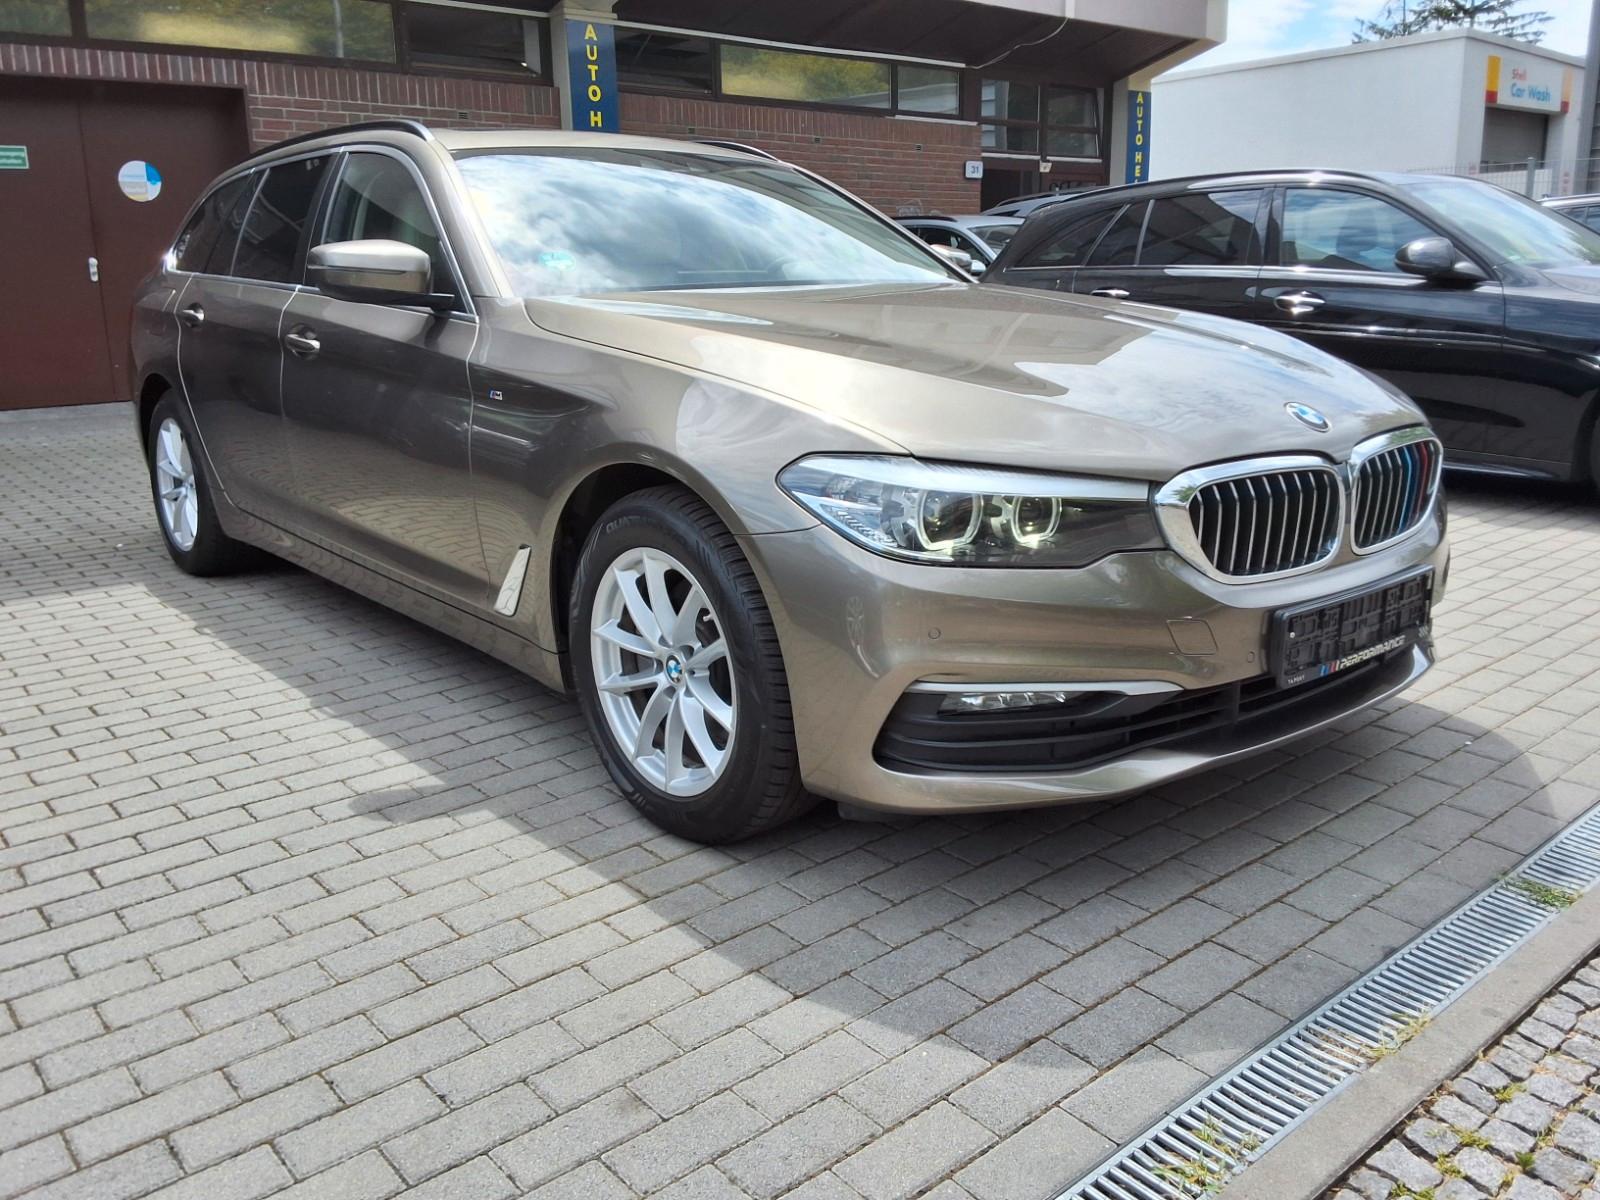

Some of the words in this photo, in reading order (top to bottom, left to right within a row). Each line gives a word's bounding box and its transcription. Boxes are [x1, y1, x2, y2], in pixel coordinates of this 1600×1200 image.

[584, 23, 602, 102] AUTO
[1511, 82, 1526, 98] Car
[1528, 85, 1551, 103] Wash
[1135, 92, 1144, 146] AUTO
[970, 165, 979, 174] 31
[1134, 151, 1143, 184] HE
[1340, 634, 1406, 669] PERFORMANCE
